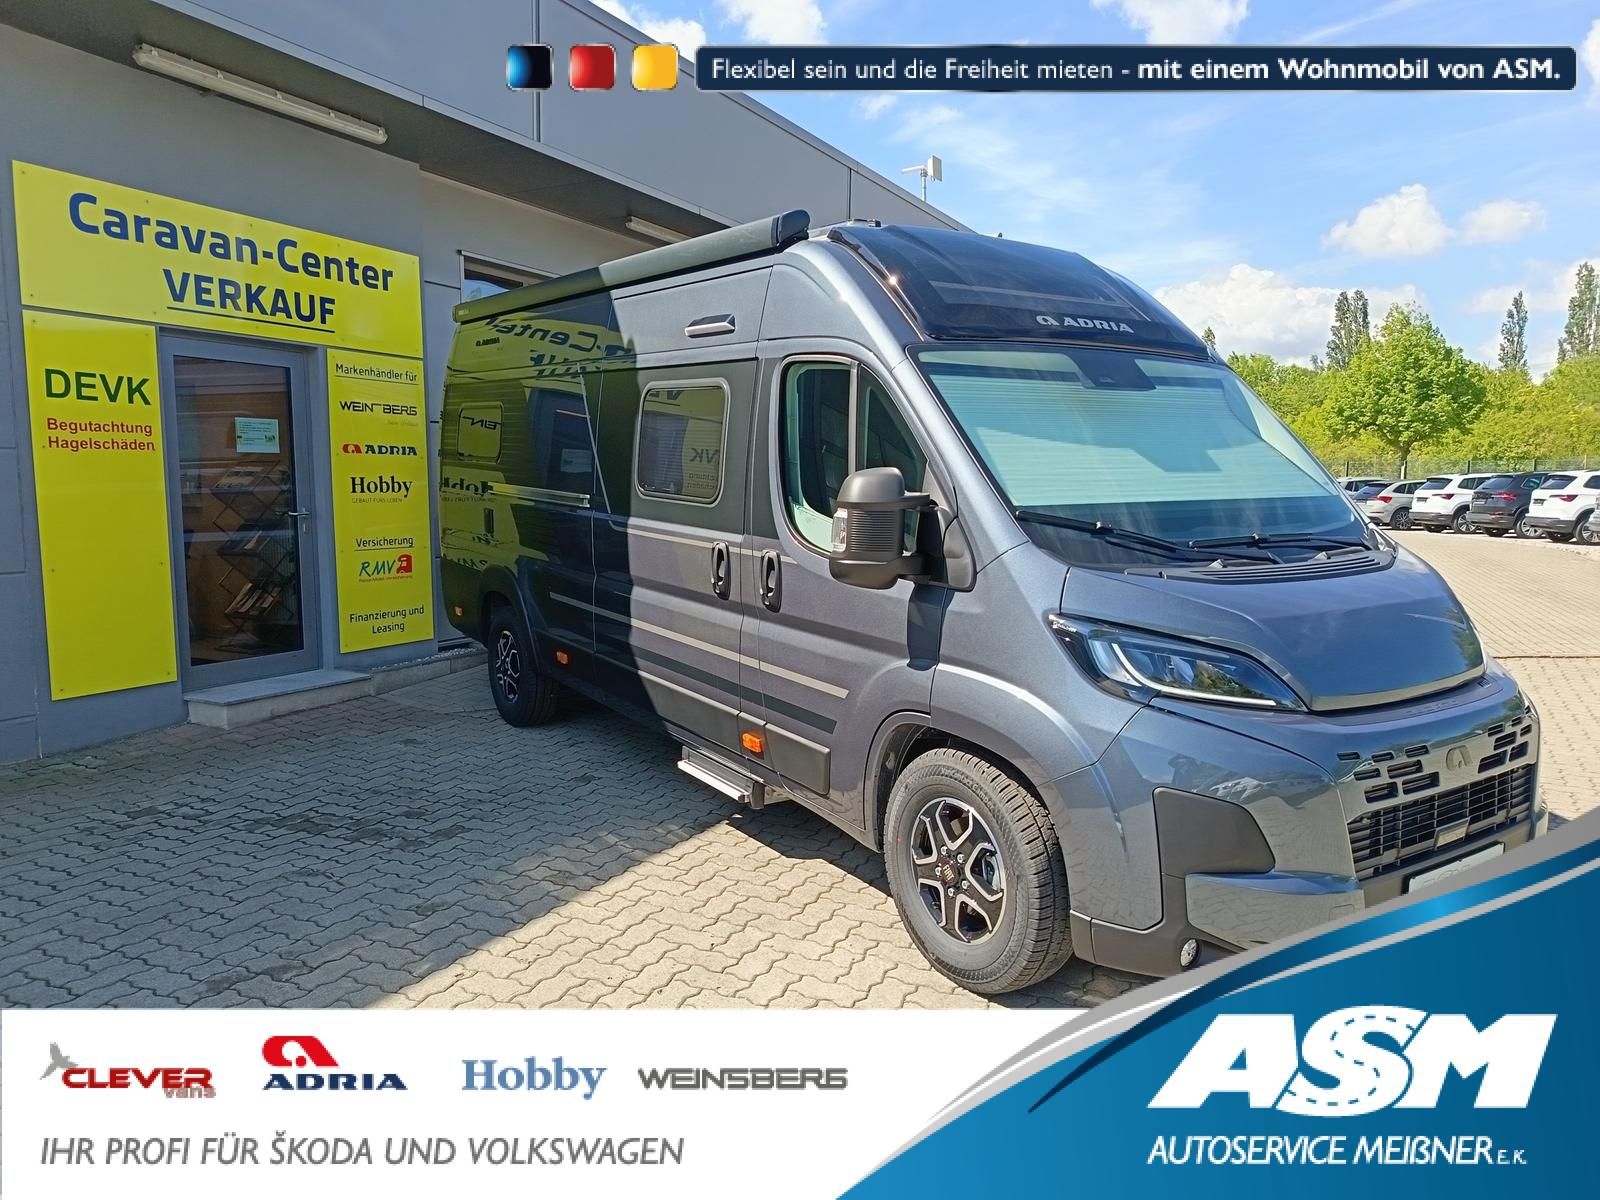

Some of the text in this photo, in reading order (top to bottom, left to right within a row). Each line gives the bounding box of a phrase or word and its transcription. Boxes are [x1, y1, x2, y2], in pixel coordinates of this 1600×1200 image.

[69, 192, 393, 291] Caravan-Center
[162, 268, 336, 325] VERKAUF
[1063, 316, 1135, 334] ADRIA
[335, 363, 418, 382] Markenhändler für
[45, 368, 152, 406] DEVK
[47, 417, 152, 437] Begutachtung
[48, 435, 155, 452] Hagelschäden
[364, 444, 418, 456] ADRIA
[350, 475, 413, 498] Hobby
[355, 537, 414, 548] Versicherung
[358, 560, 396, 577] RMV
[349, 604, 425, 623] Finanzierung und
[372, 622, 405, 634] Leasing
[942, 864, 955, 881] FIAT
